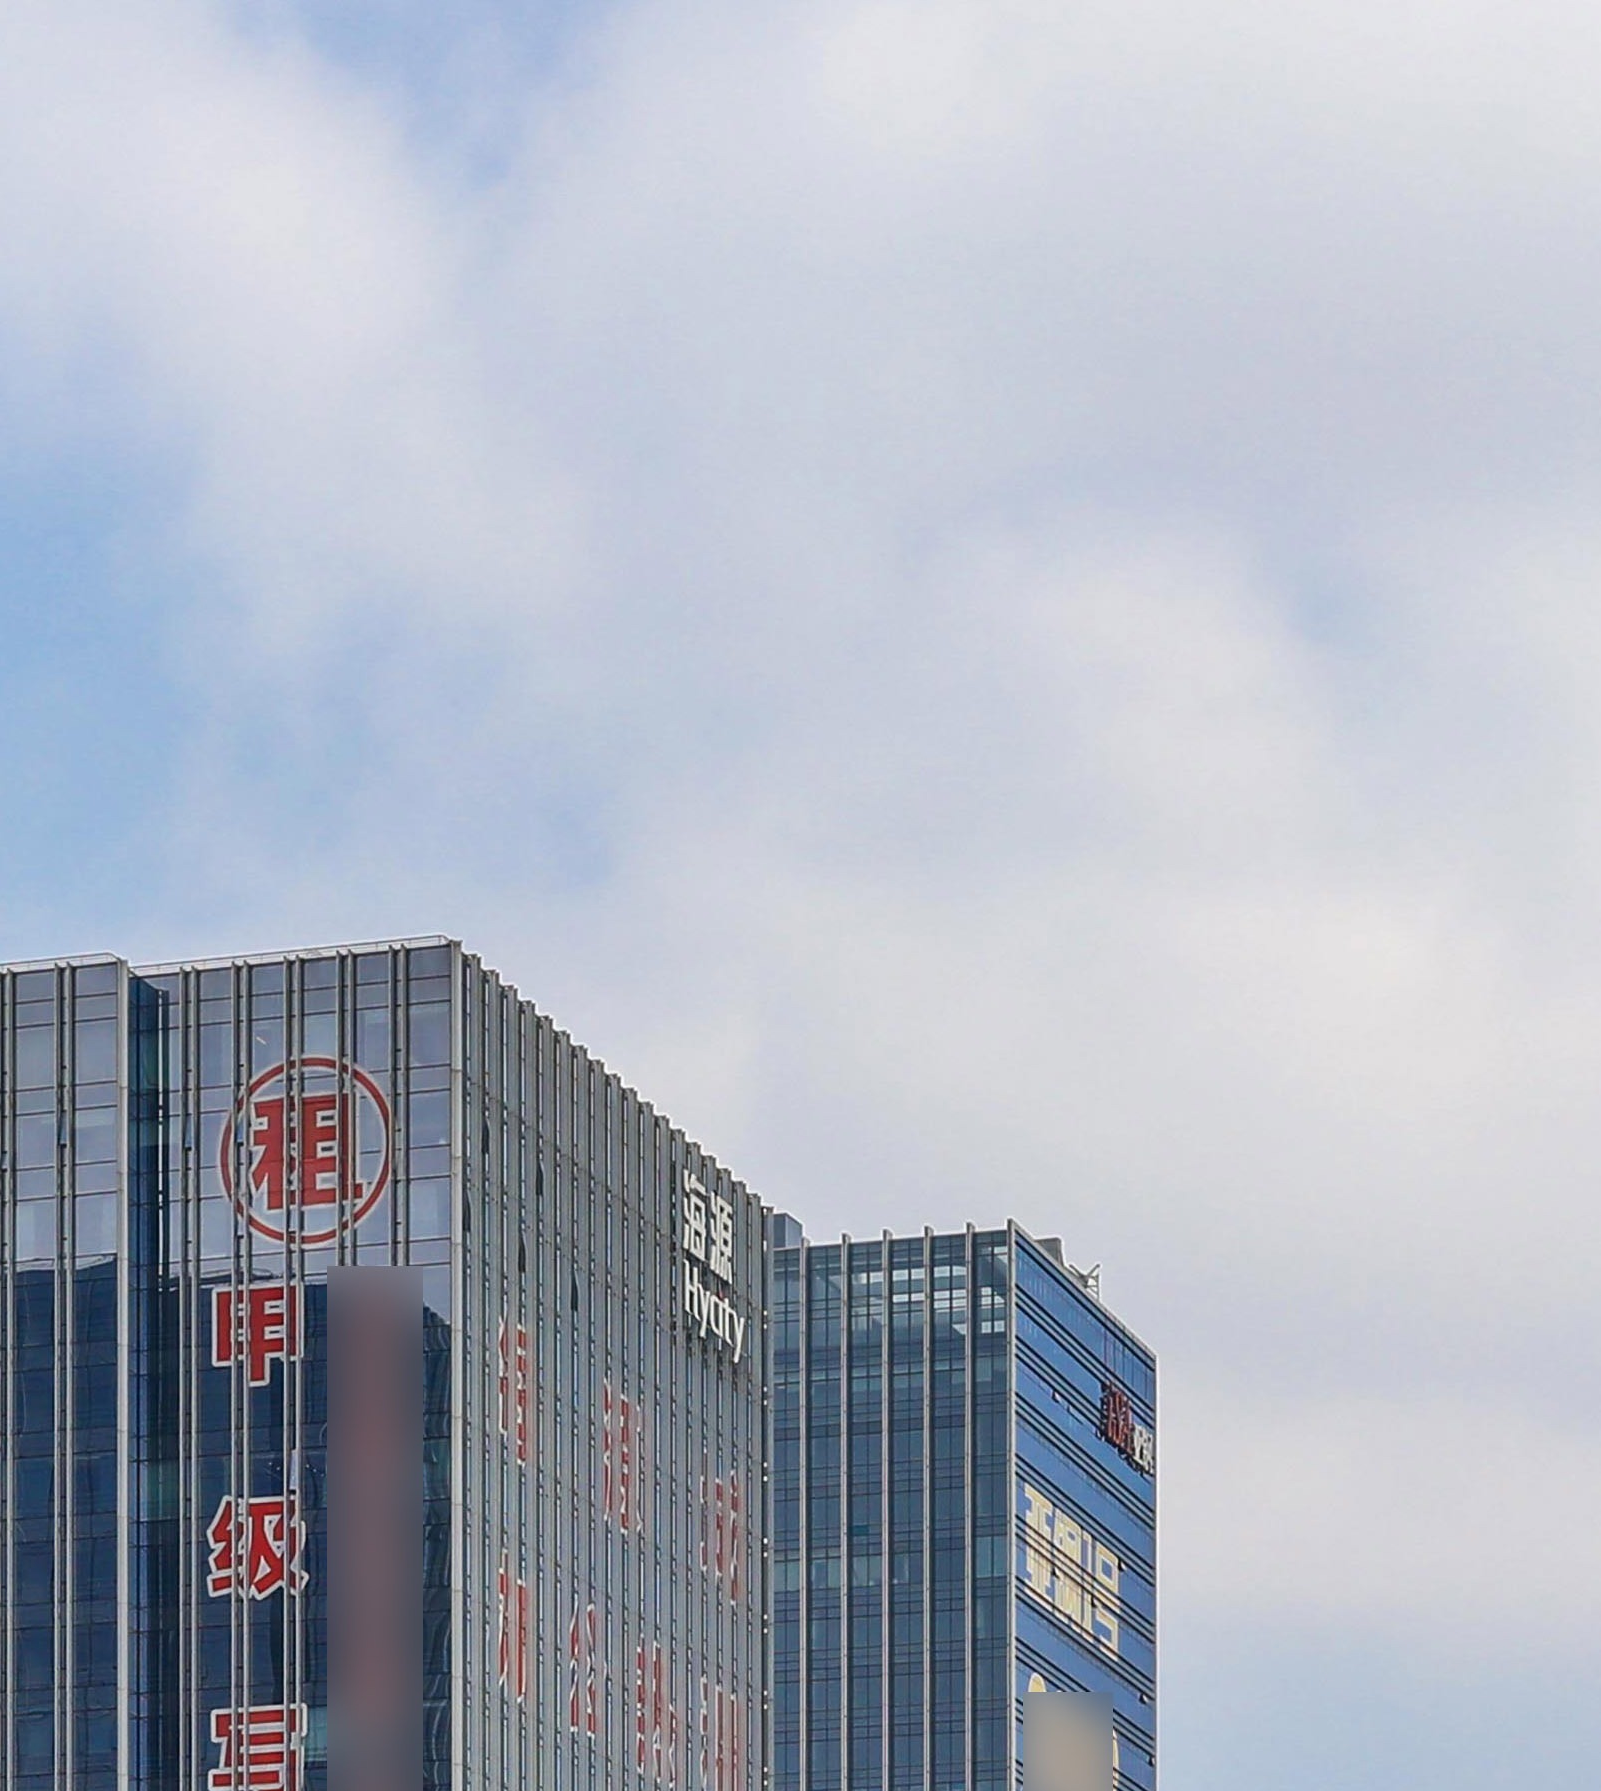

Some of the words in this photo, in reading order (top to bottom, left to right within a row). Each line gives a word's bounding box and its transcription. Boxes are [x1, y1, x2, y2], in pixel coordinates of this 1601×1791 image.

[248, 1092, 366, 1213] 租
[683, 1168, 734, 1285] 海源
[683, 1257, 745, 1364] Hycity
